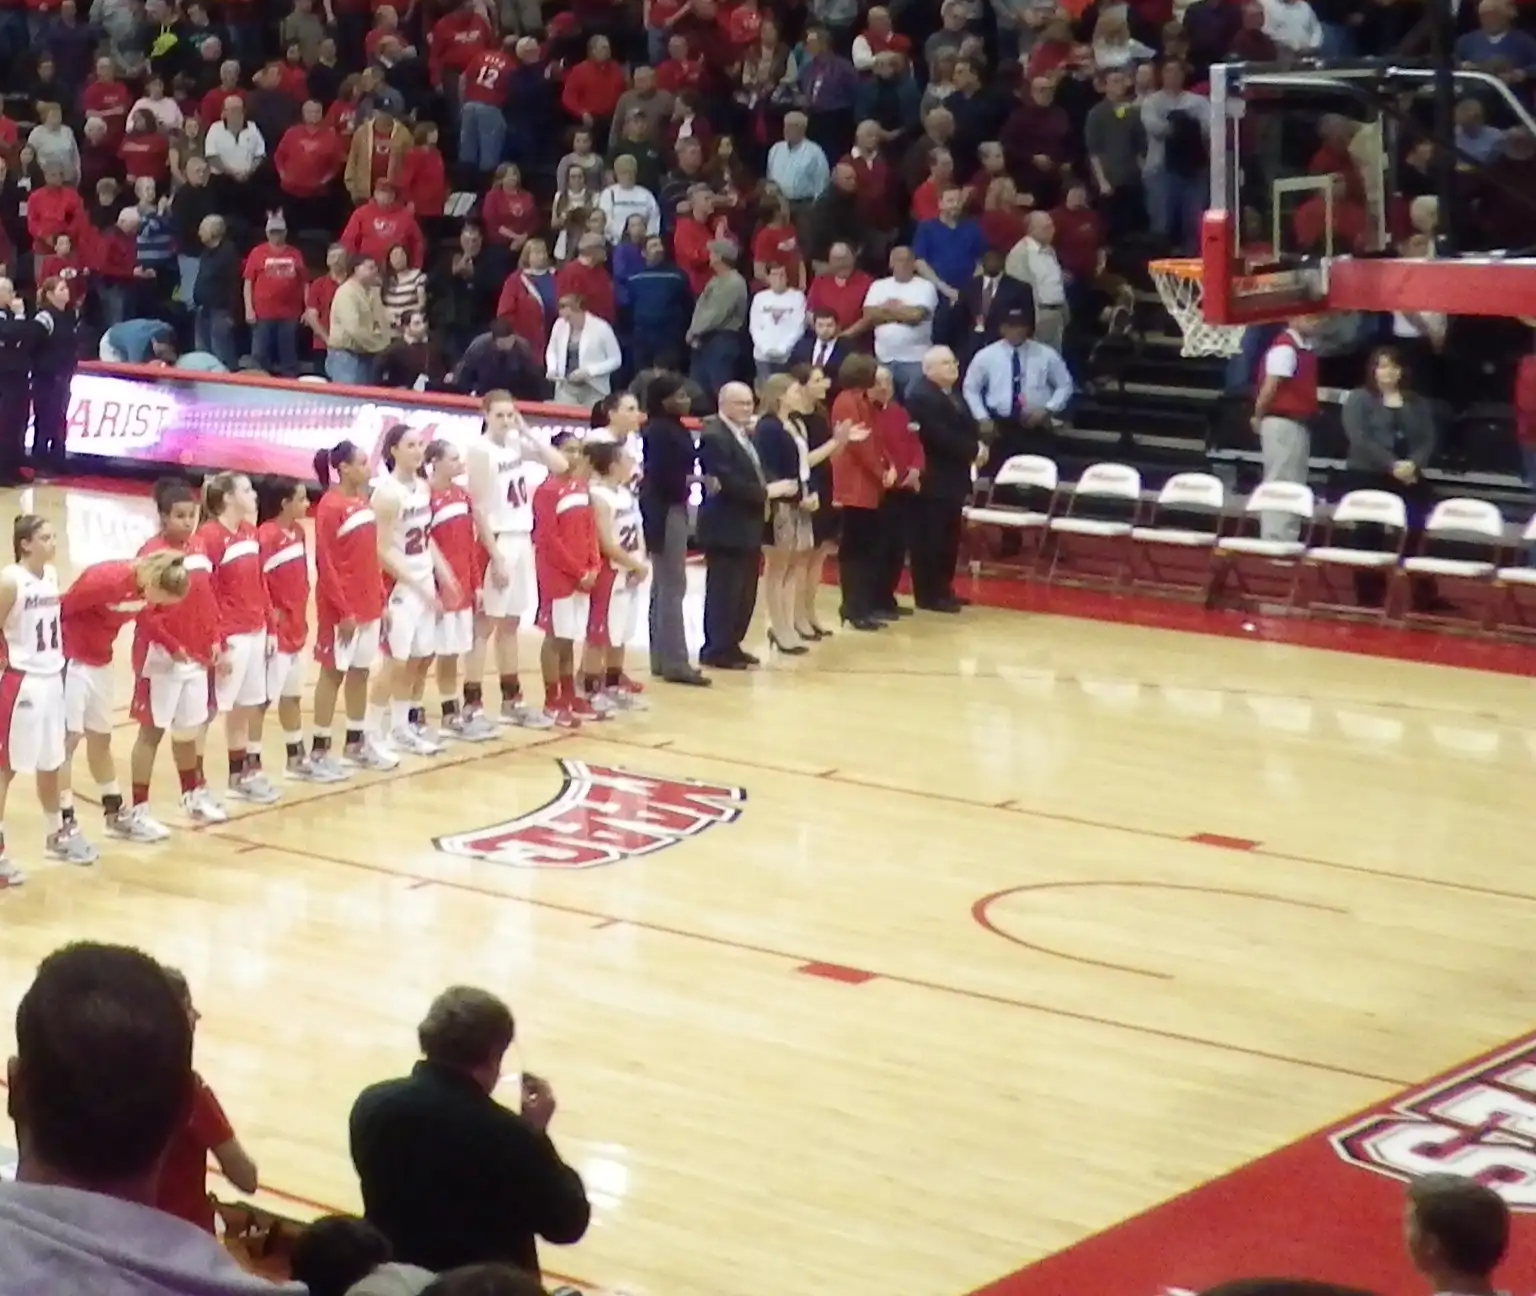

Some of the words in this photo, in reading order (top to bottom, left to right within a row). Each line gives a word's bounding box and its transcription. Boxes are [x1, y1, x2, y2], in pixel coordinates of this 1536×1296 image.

[476, 65, 499, 89] 12
[66, 399, 170, 438] ARIST
[507, 475, 528, 509] 40
[35, 615, 59, 653] 11
